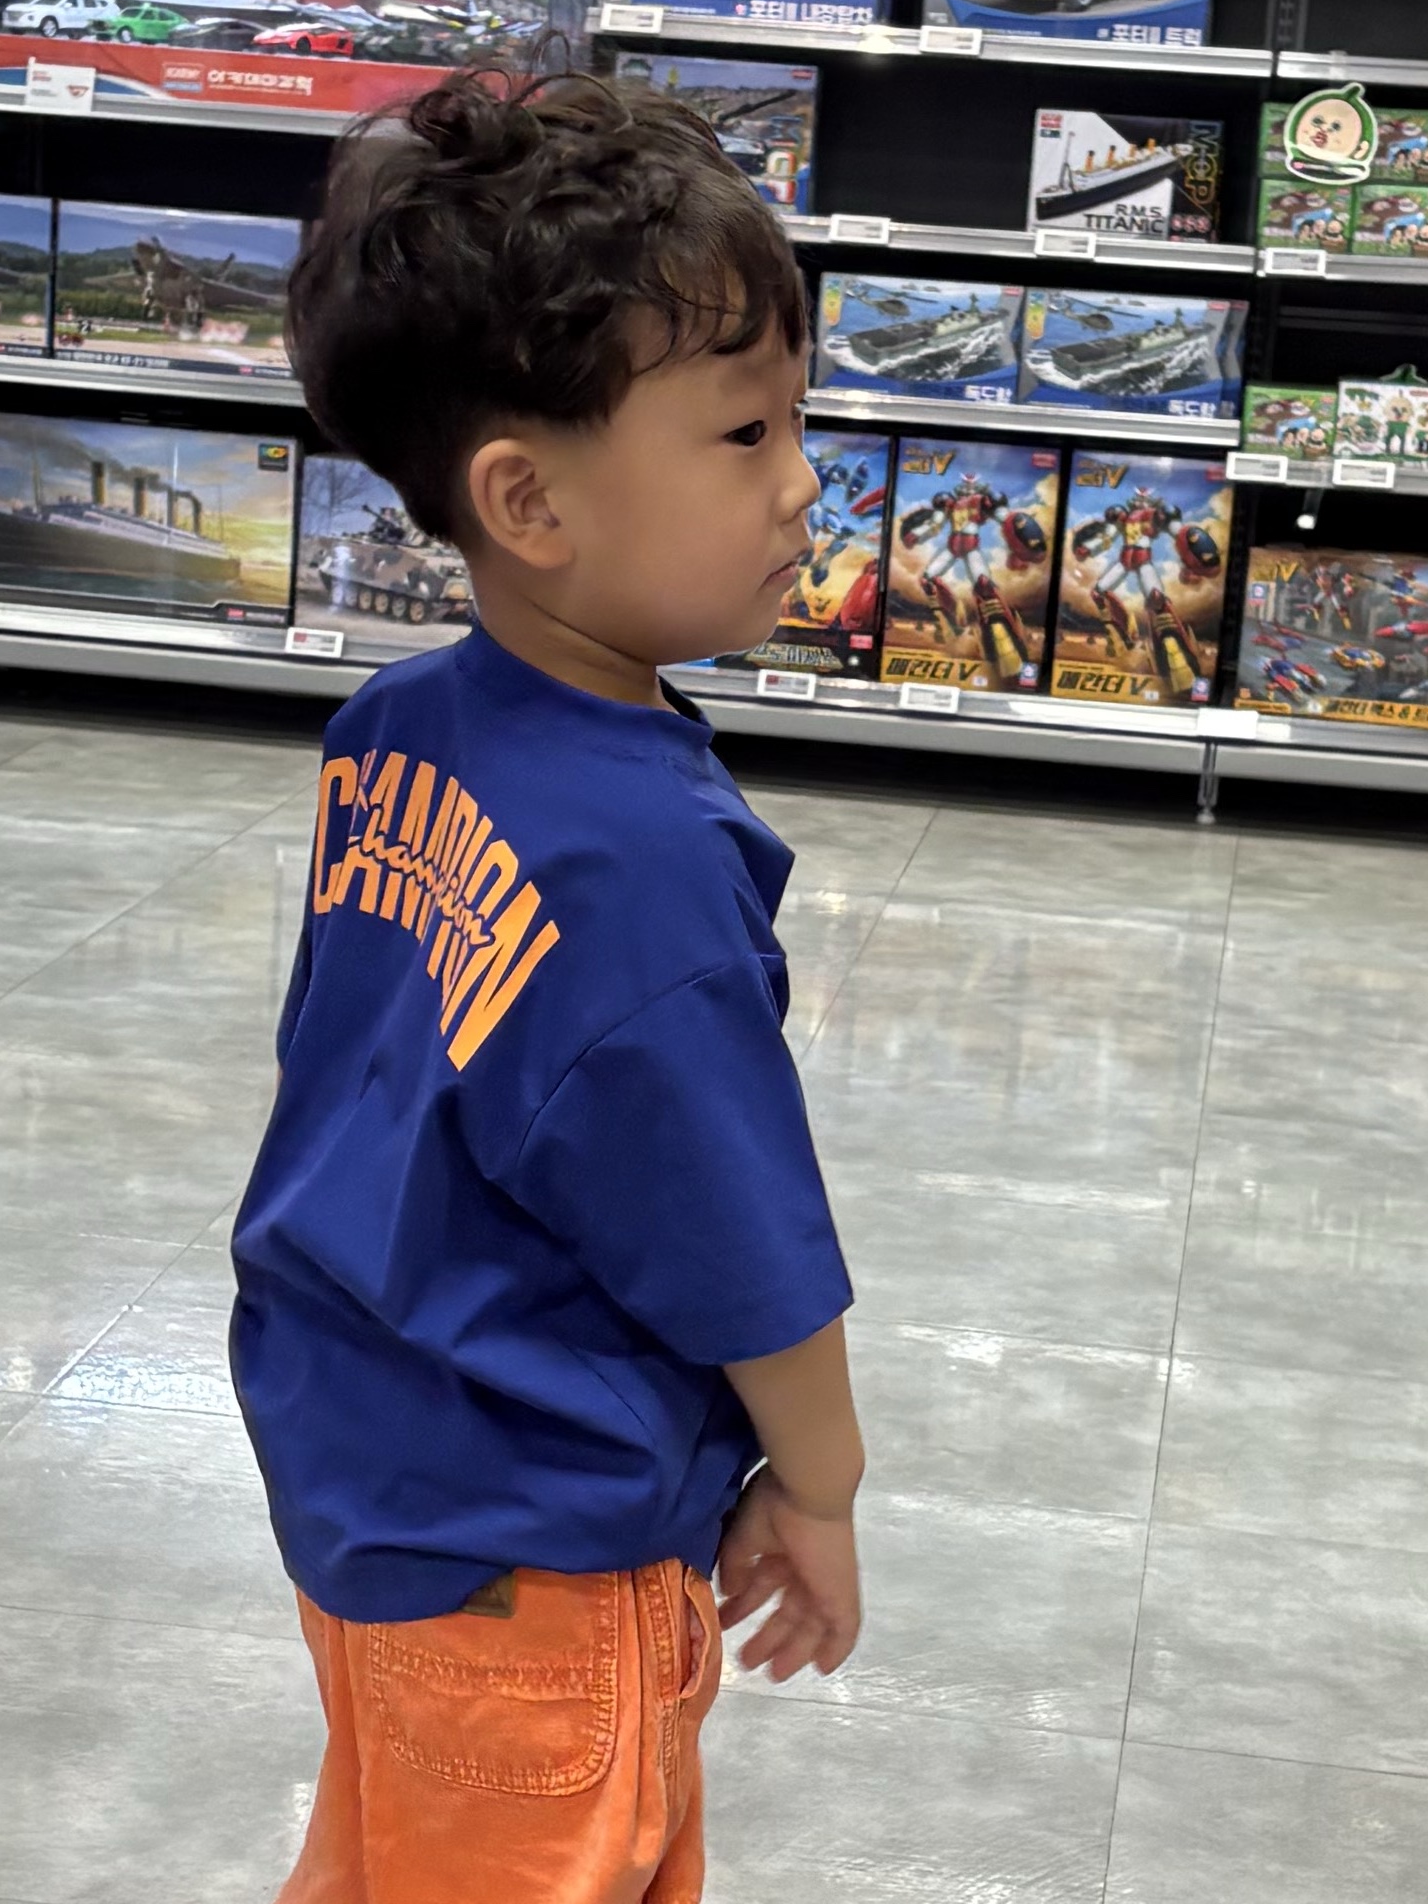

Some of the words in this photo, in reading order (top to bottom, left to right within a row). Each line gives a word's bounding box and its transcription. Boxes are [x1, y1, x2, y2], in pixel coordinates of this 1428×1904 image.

[1085, 214, 1164, 233] TITANIC
[956, 662, 978, 682] V
[1129, 677, 1151, 697] V
